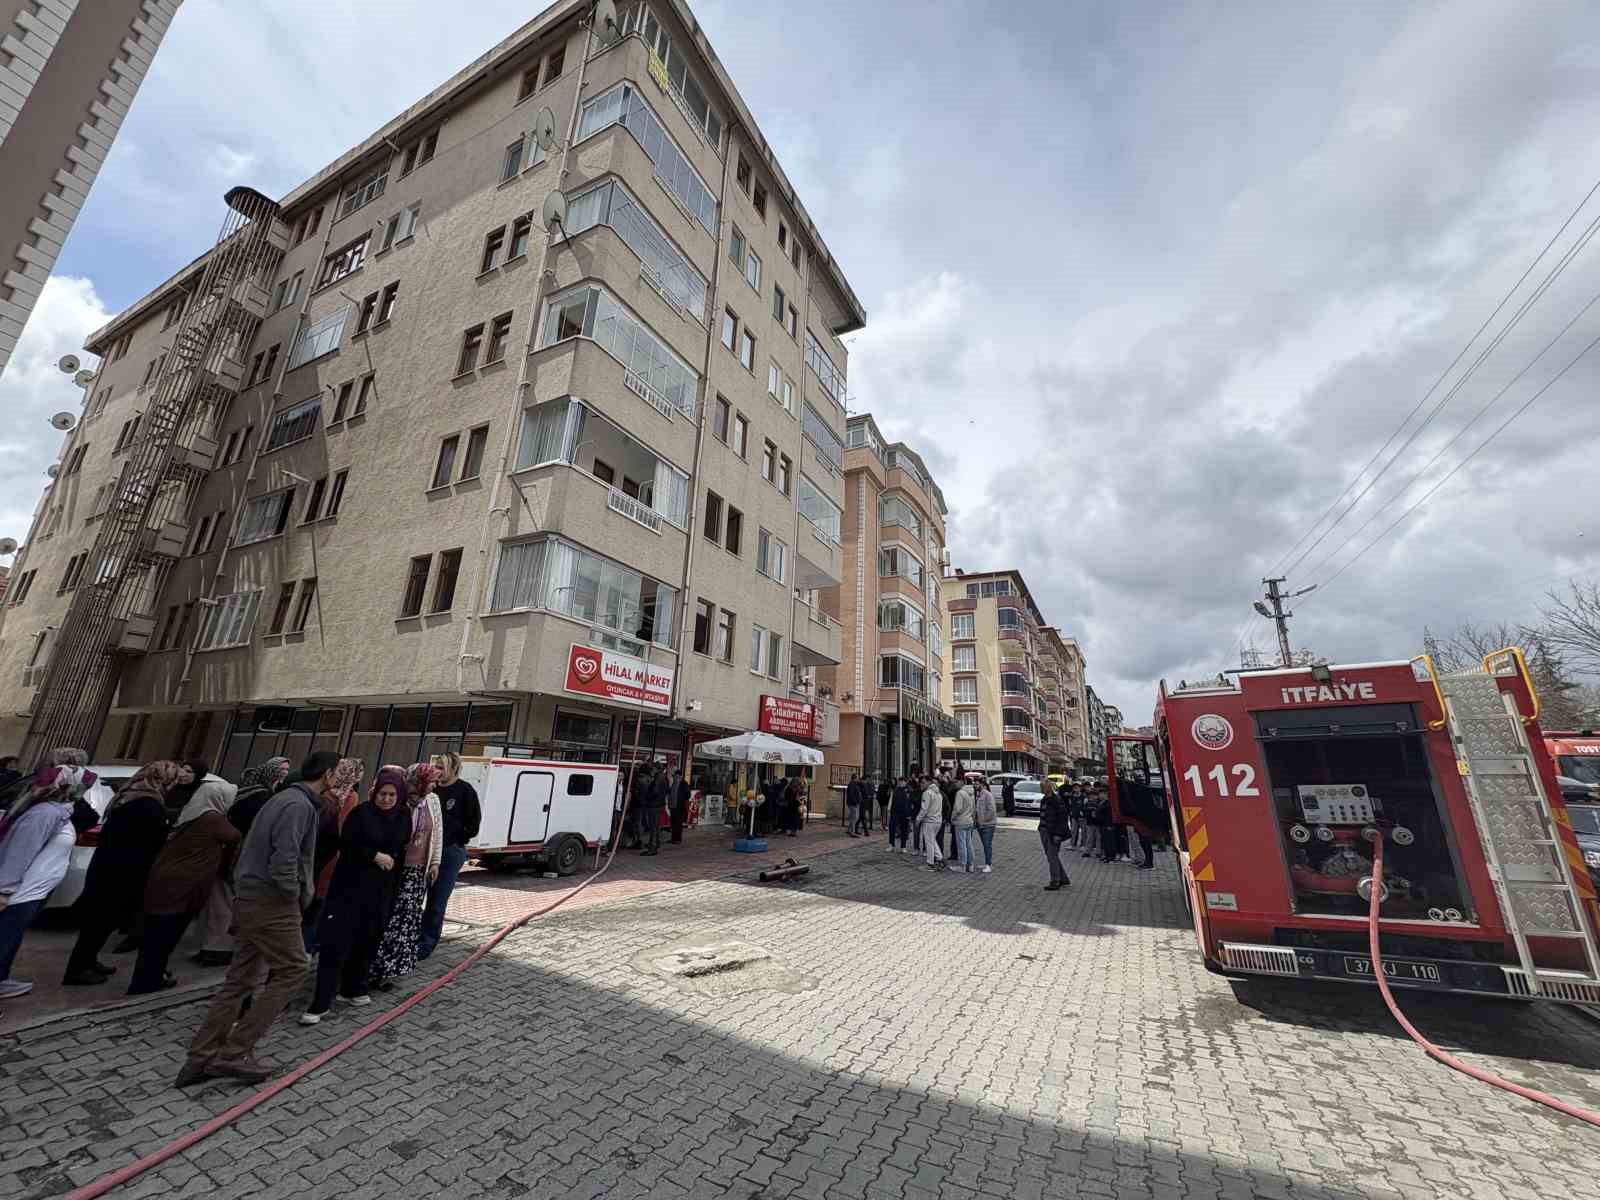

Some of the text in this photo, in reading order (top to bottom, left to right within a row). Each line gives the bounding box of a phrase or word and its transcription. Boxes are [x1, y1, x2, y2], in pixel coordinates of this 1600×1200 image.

[604, 661, 671, 689] HİLAL MARKET
[1184, 763, 1260, 797] 112
[1354, 959, 1370, 973] 37
[1411, 964, 1437, 980] 110
